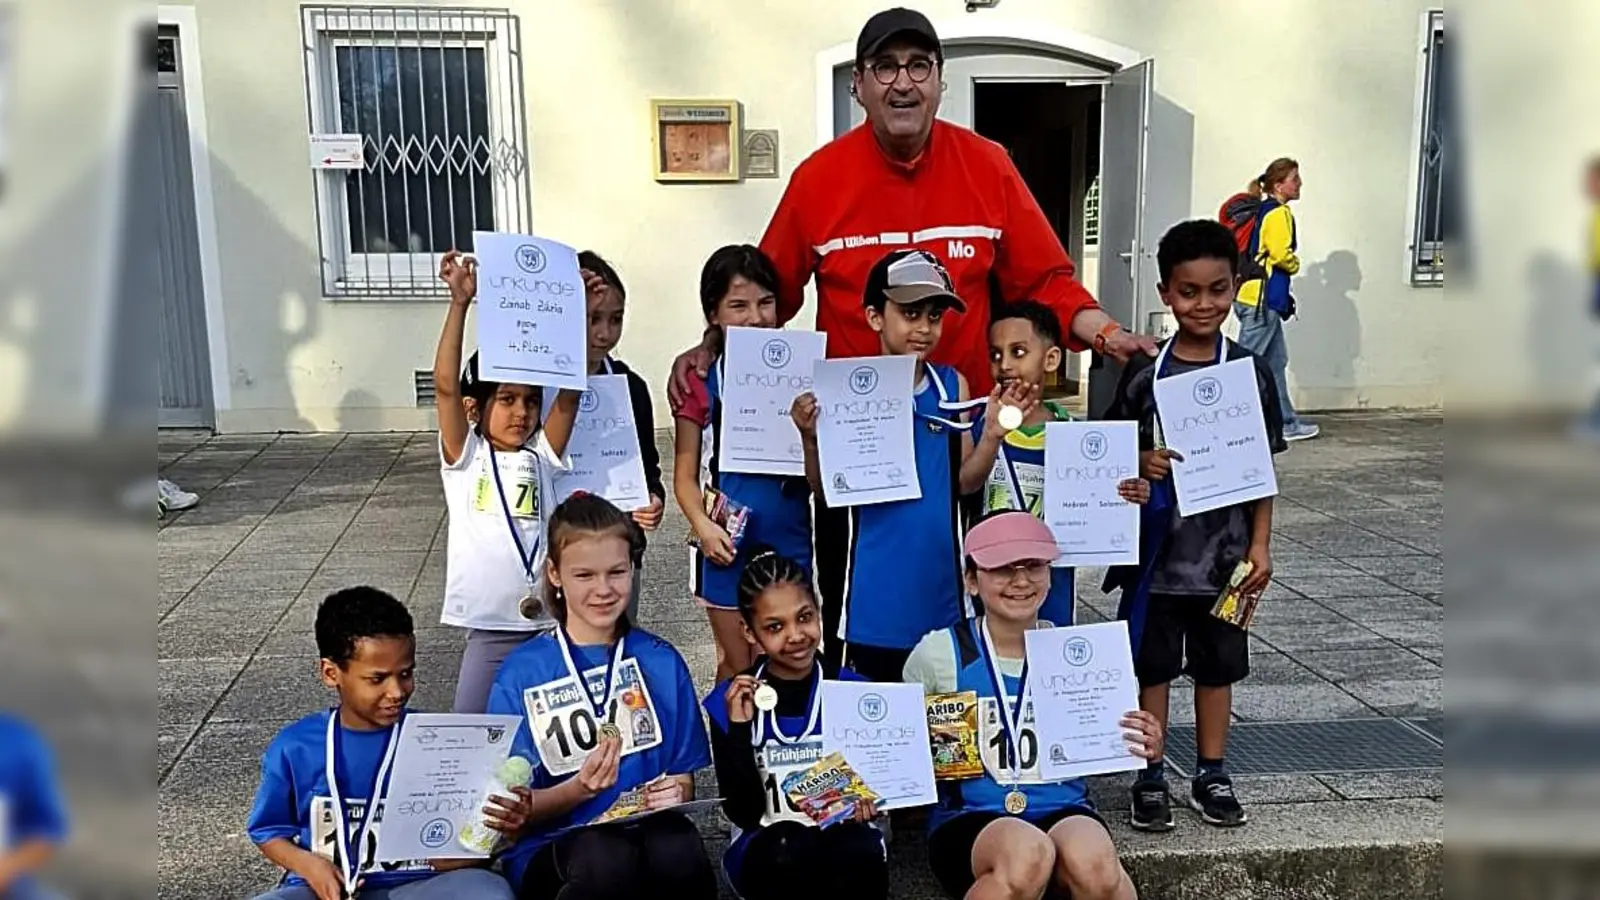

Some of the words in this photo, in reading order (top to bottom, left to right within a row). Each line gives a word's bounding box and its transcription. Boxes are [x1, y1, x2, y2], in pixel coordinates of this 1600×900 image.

[844, 235, 879, 248] Wilson
[947, 241, 975, 259] Mo
[927, 702, 964, 716] ARIBO
[796, 768, 840, 793] HARIBO
